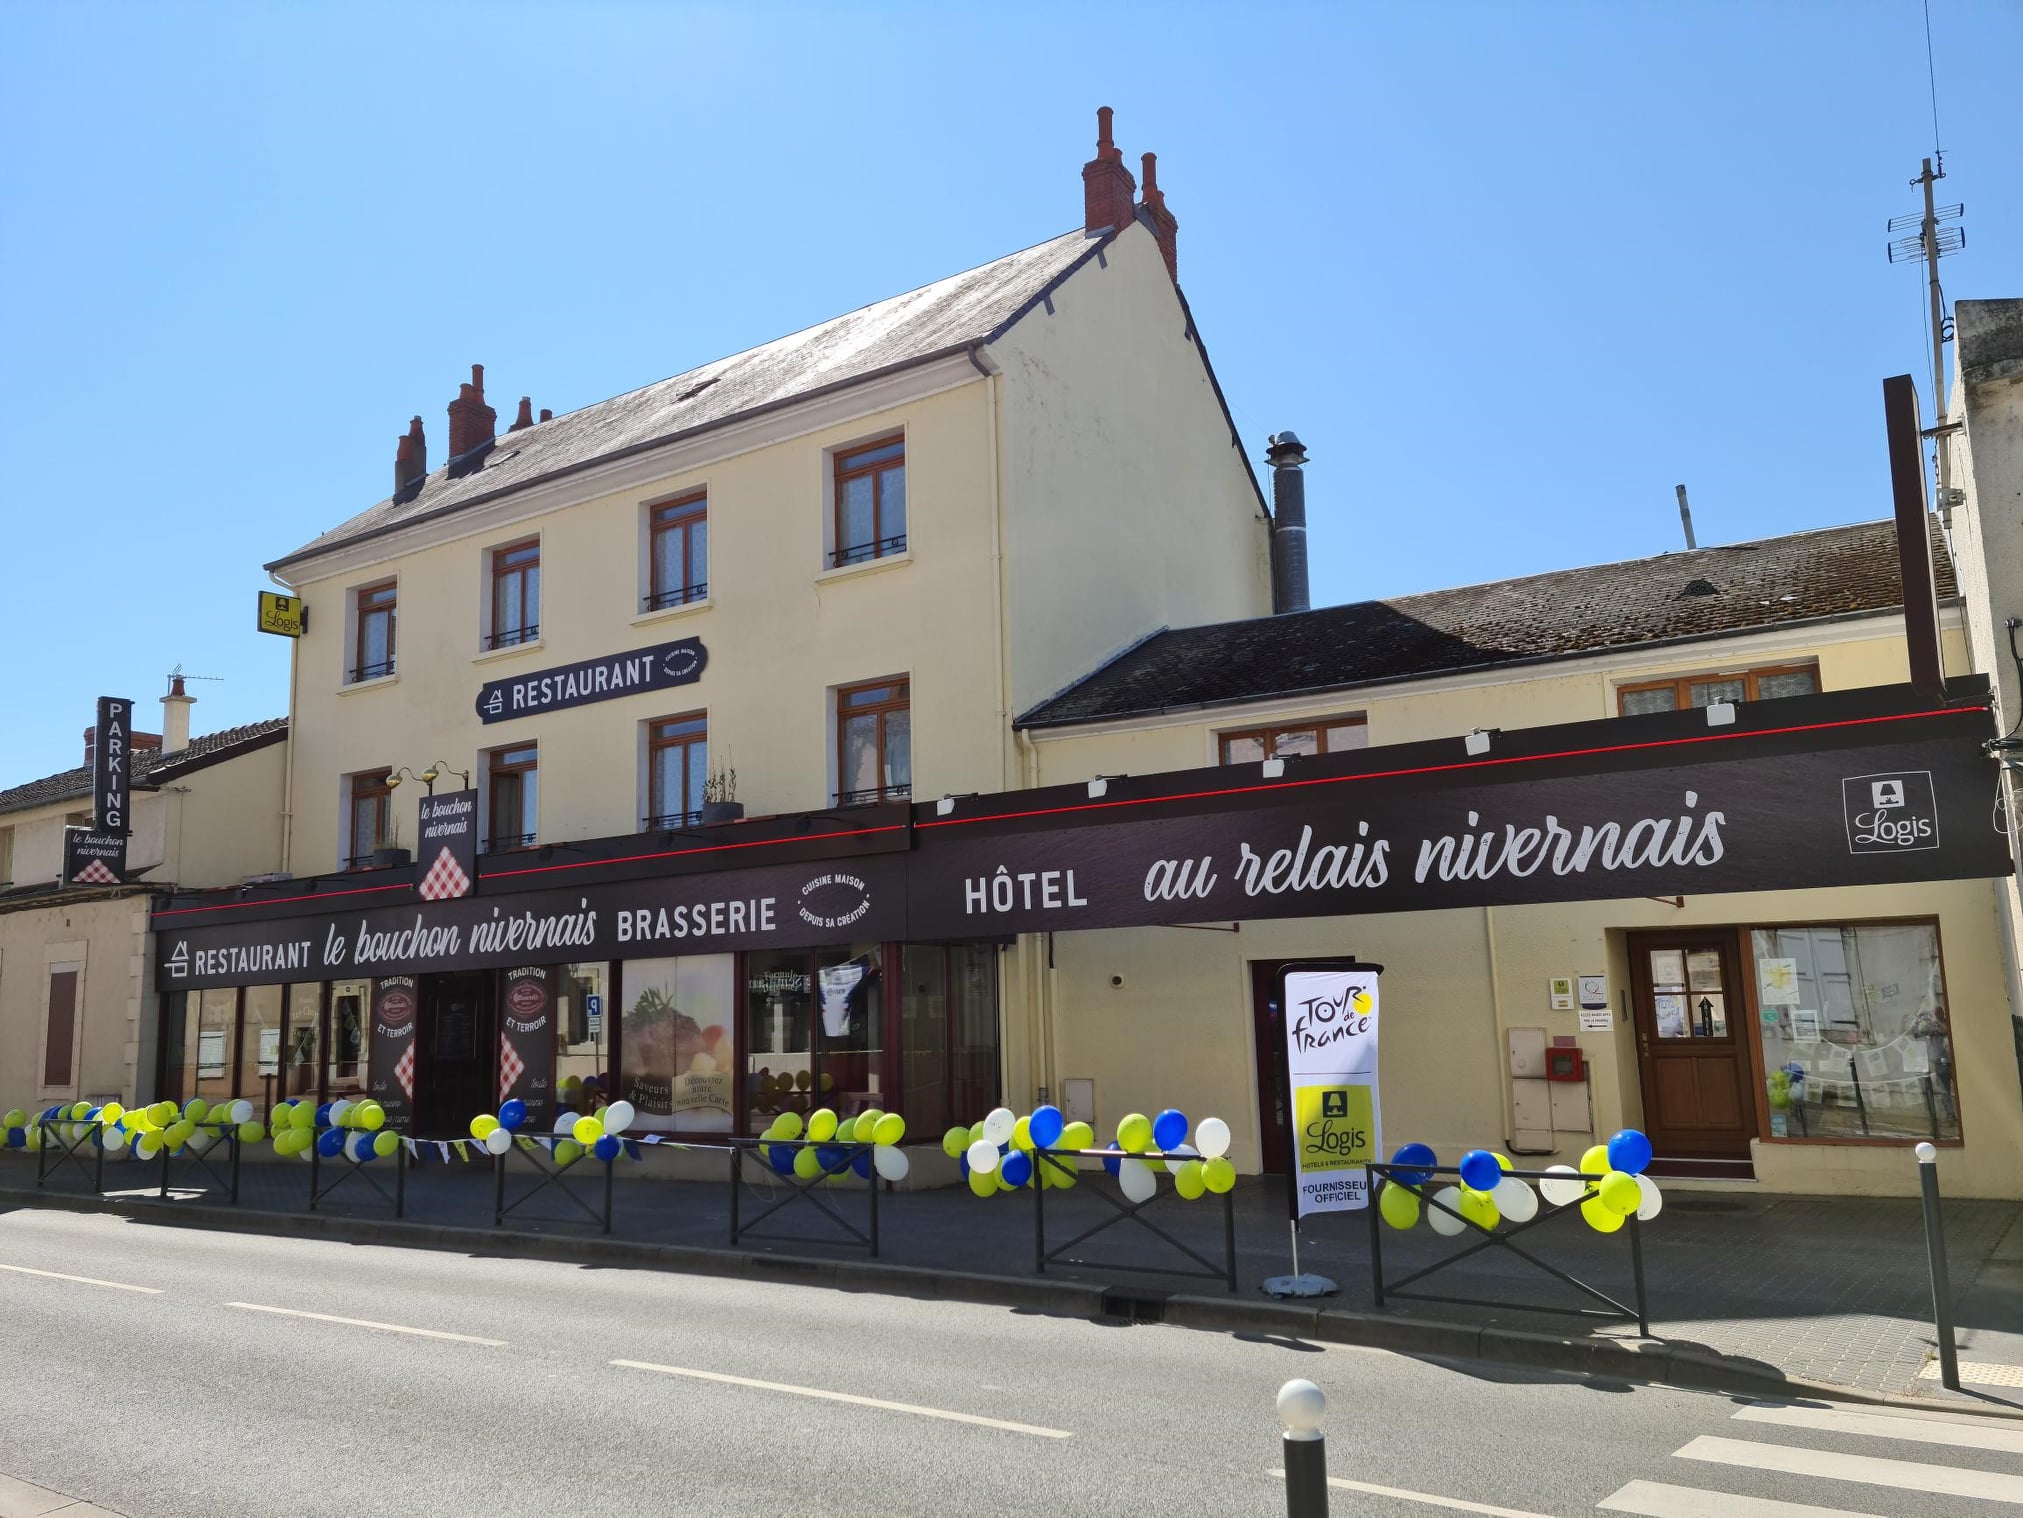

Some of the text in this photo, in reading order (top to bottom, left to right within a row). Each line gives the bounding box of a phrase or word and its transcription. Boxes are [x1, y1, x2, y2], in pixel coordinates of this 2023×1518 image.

[265, 611, 299, 632] Logis
[512, 655, 654, 710] RESTAURANT
[106, 702, 123, 827] PARKING
[421, 797, 472, 820] le bouchon
[425, 816, 467, 838] nivernais
[1855, 808, 1932, 845] Logis
[73, 833, 124, 846] le bouchon
[76, 845, 119, 857] nivernais
[964, 790, 1726, 914] HÔTEL au relais nivernais
[802, 873, 865, 896] CUISINE MAISON
[799, 900, 870, 928] DEPUIS SA CRÉATION
[195, 897, 777, 976] RESTAURANT le bouchon nivernais BRASSERIE
[380, 976, 414, 990] TRADITION
[508, 966, 546, 980] TRADITION
[506, 1015, 547, 1032] ET TERROIR
[1344, 1010, 1355, 1021] de
[377, 1022, 414, 1038] ET TERROIR
[633, 1077, 669, 1095] Saveurs
[1306, 1119, 1366, 1156] Logis
[1302, 1180, 1367, 1195] FOURNISSEU
[1315, 1192, 1361, 1203] OFFICIEL
